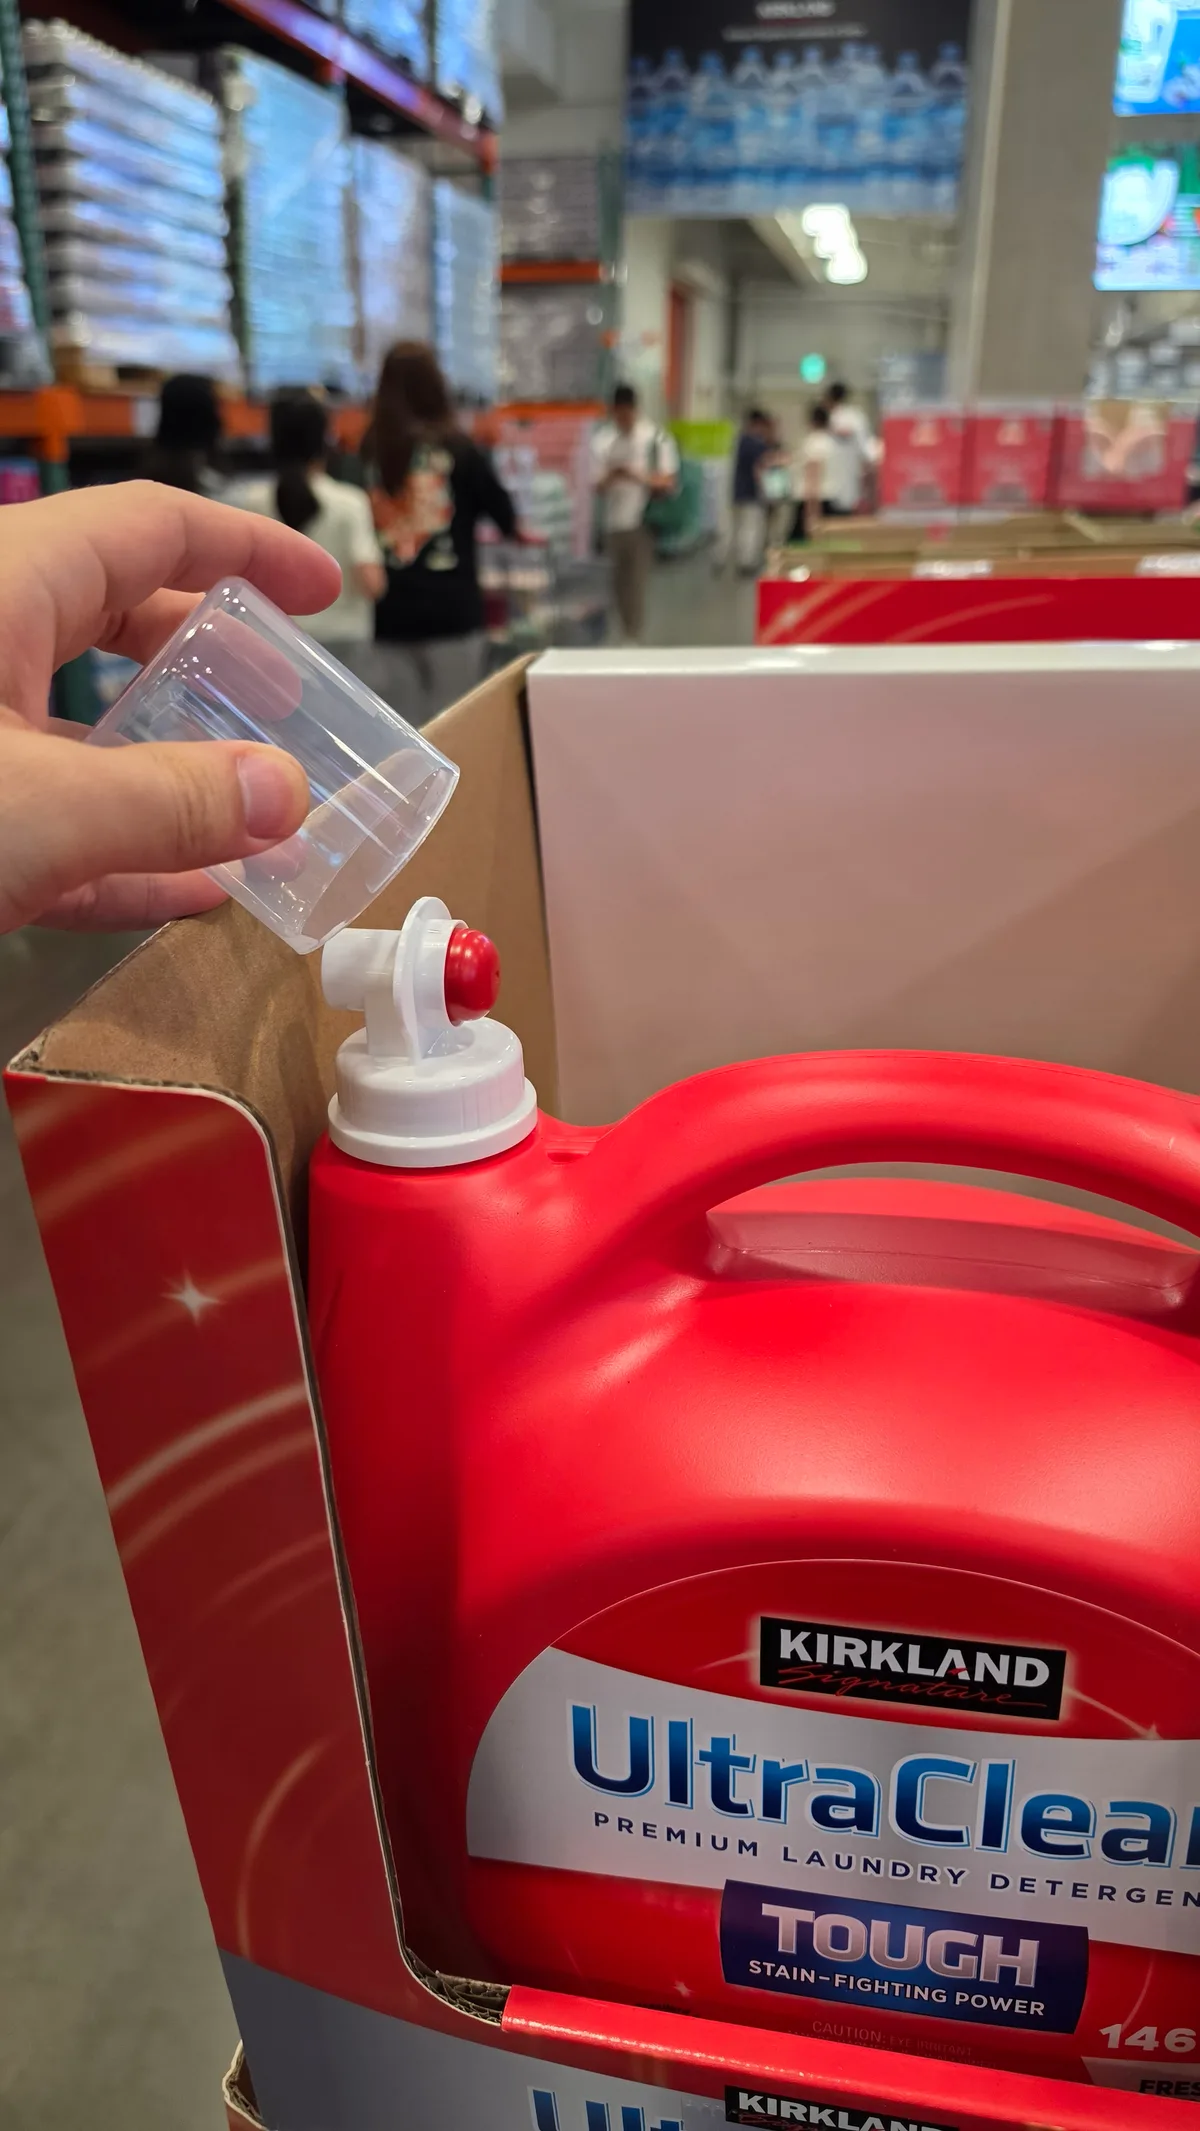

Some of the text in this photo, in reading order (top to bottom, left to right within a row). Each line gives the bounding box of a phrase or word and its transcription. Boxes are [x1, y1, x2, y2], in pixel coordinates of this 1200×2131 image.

[778, 1664, 1047, 1707] Signature
[780, 1628, 1049, 1688] KIRKLAND
[572, 1704, 1200, 1870] UltraClea
[594, 1811, 758, 1857] PREMIUM
[783, 1846, 966, 1885] LAUNDRY
[762, 1903, 1040, 1988] TOUGH
[749, 1959, 1045, 2017] STAIN-FIGHTING POWER
[812, 2020, 887, 2044] CAUTION:
[1099, 2024, 1197, 2053] 146
